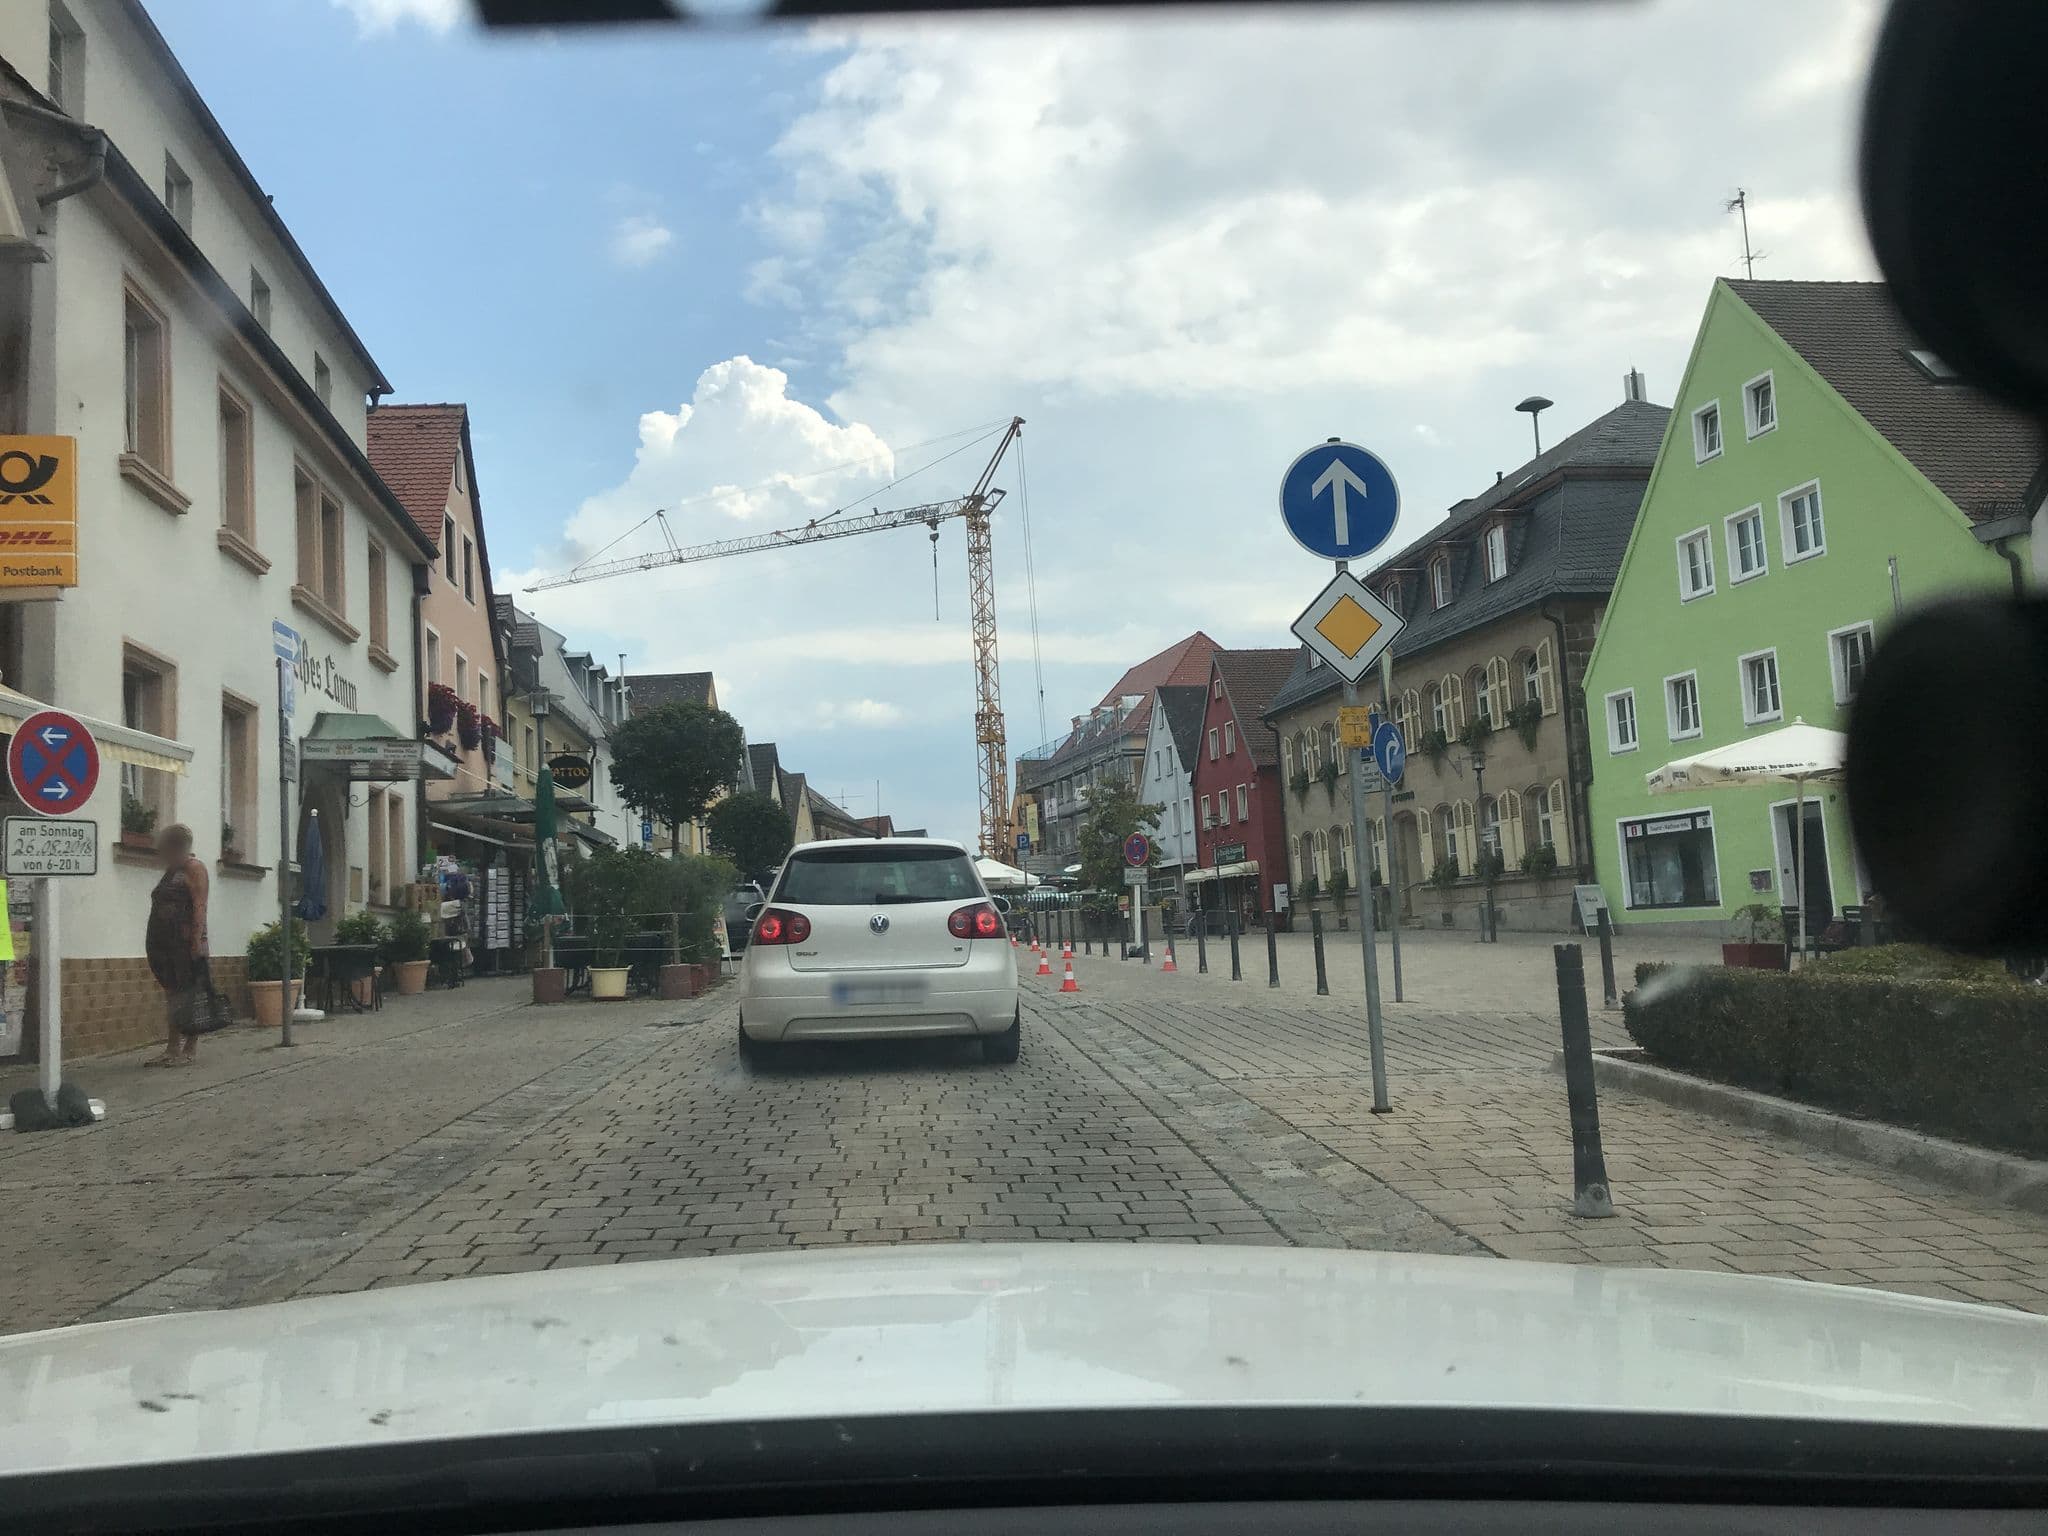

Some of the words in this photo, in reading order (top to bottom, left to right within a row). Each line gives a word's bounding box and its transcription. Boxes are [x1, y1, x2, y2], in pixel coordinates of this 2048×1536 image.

[3, 565, 63, 577] Postbank
[551, 767, 589, 777] ATTOO
[20, 827, 37, 836] am
[40, 825, 84, 840] Sonntag
[23, 861, 42, 870] von
[47, 859, 71, 870] 6-20
[75, 860, 80, 870] h
